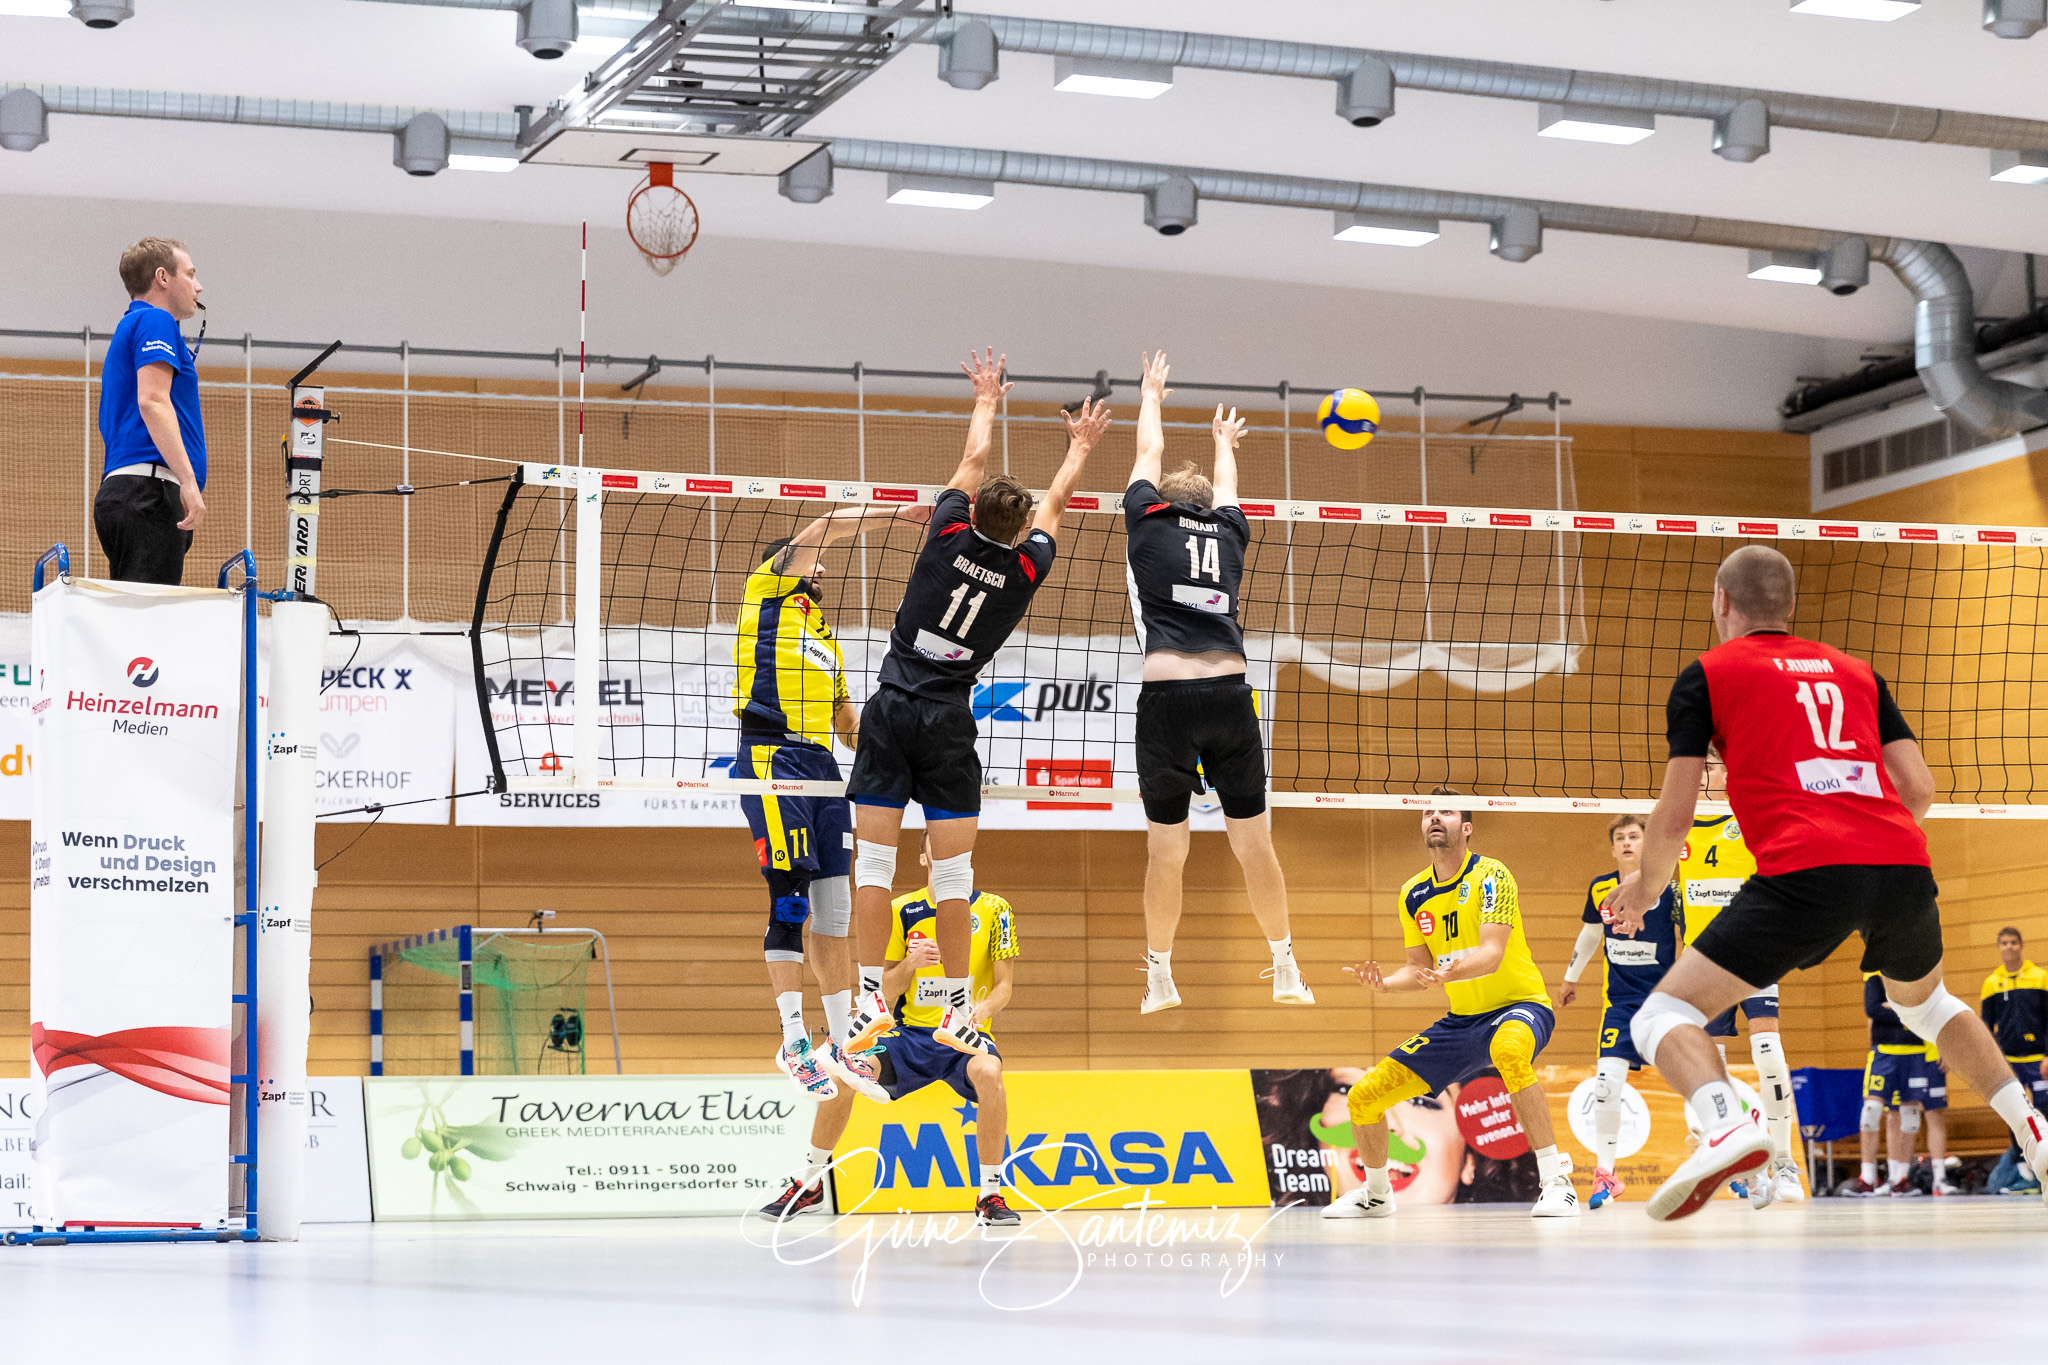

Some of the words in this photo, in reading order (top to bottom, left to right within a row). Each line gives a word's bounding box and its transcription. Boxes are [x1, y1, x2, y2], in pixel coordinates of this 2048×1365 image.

[1179, 516, 1218, 532] BONADT
[294, 517, 310, 595] ERARD
[1185, 534, 1220, 584] 14
[952, 554, 1006, 589] BRAETSCH
[938, 582, 988, 640] 11
[484, 677, 644, 706] MEYEL
[1034, 672, 1114, 722] puls
[66, 690, 219, 719] Heinzelmann
[1795, 680, 1857, 750] 12
[112, 719, 169, 736] Medien
[273, 744, 298, 755] Zapf
[1054, 774, 1102, 786] Sparkasse
[500, 793, 600, 808] SERVICES
[61, 831, 118, 849] Wenn
[123, 834, 186, 852] Druck
[790, 828, 809, 858] 11
[100, 854, 140, 871] und
[145, 855, 216, 874] Design
[1704, 845, 1718, 868] 4
[68, 874, 210, 894] verschmelzen
[266, 918, 292, 928] Zapf
[1442, 910, 1459, 942] 10
[924, 989, 944, 998] Zapf
[262, 1092, 286, 1102] Zapf
[492, 1094, 692, 1123] Taverna
[1458, 1100, 1489, 1118] Mehr
[1480, 1109, 1512, 1128] unter
[506, 1126, 562, 1138] GREEK
[567, 1125, 714, 1138] MEDITERRANEAN
[719, 1124, 786, 1136] CUISINE
[1271, 1143, 1339, 1168] Dream
[566, 1165, 602, 1176] Tel.:
[609, 1164, 651, 1175] 0911
[669, 1164, 700, 1174] 500
[706, 1164, 738, 1174] 200
[506, 1180, 576, 1194] Schwaig
[595, 1178, 739, 1192] Behringersdorfer
[744, 1178, 774, 1189] Str.
[1274, 1168, 1330, 1193] Team
